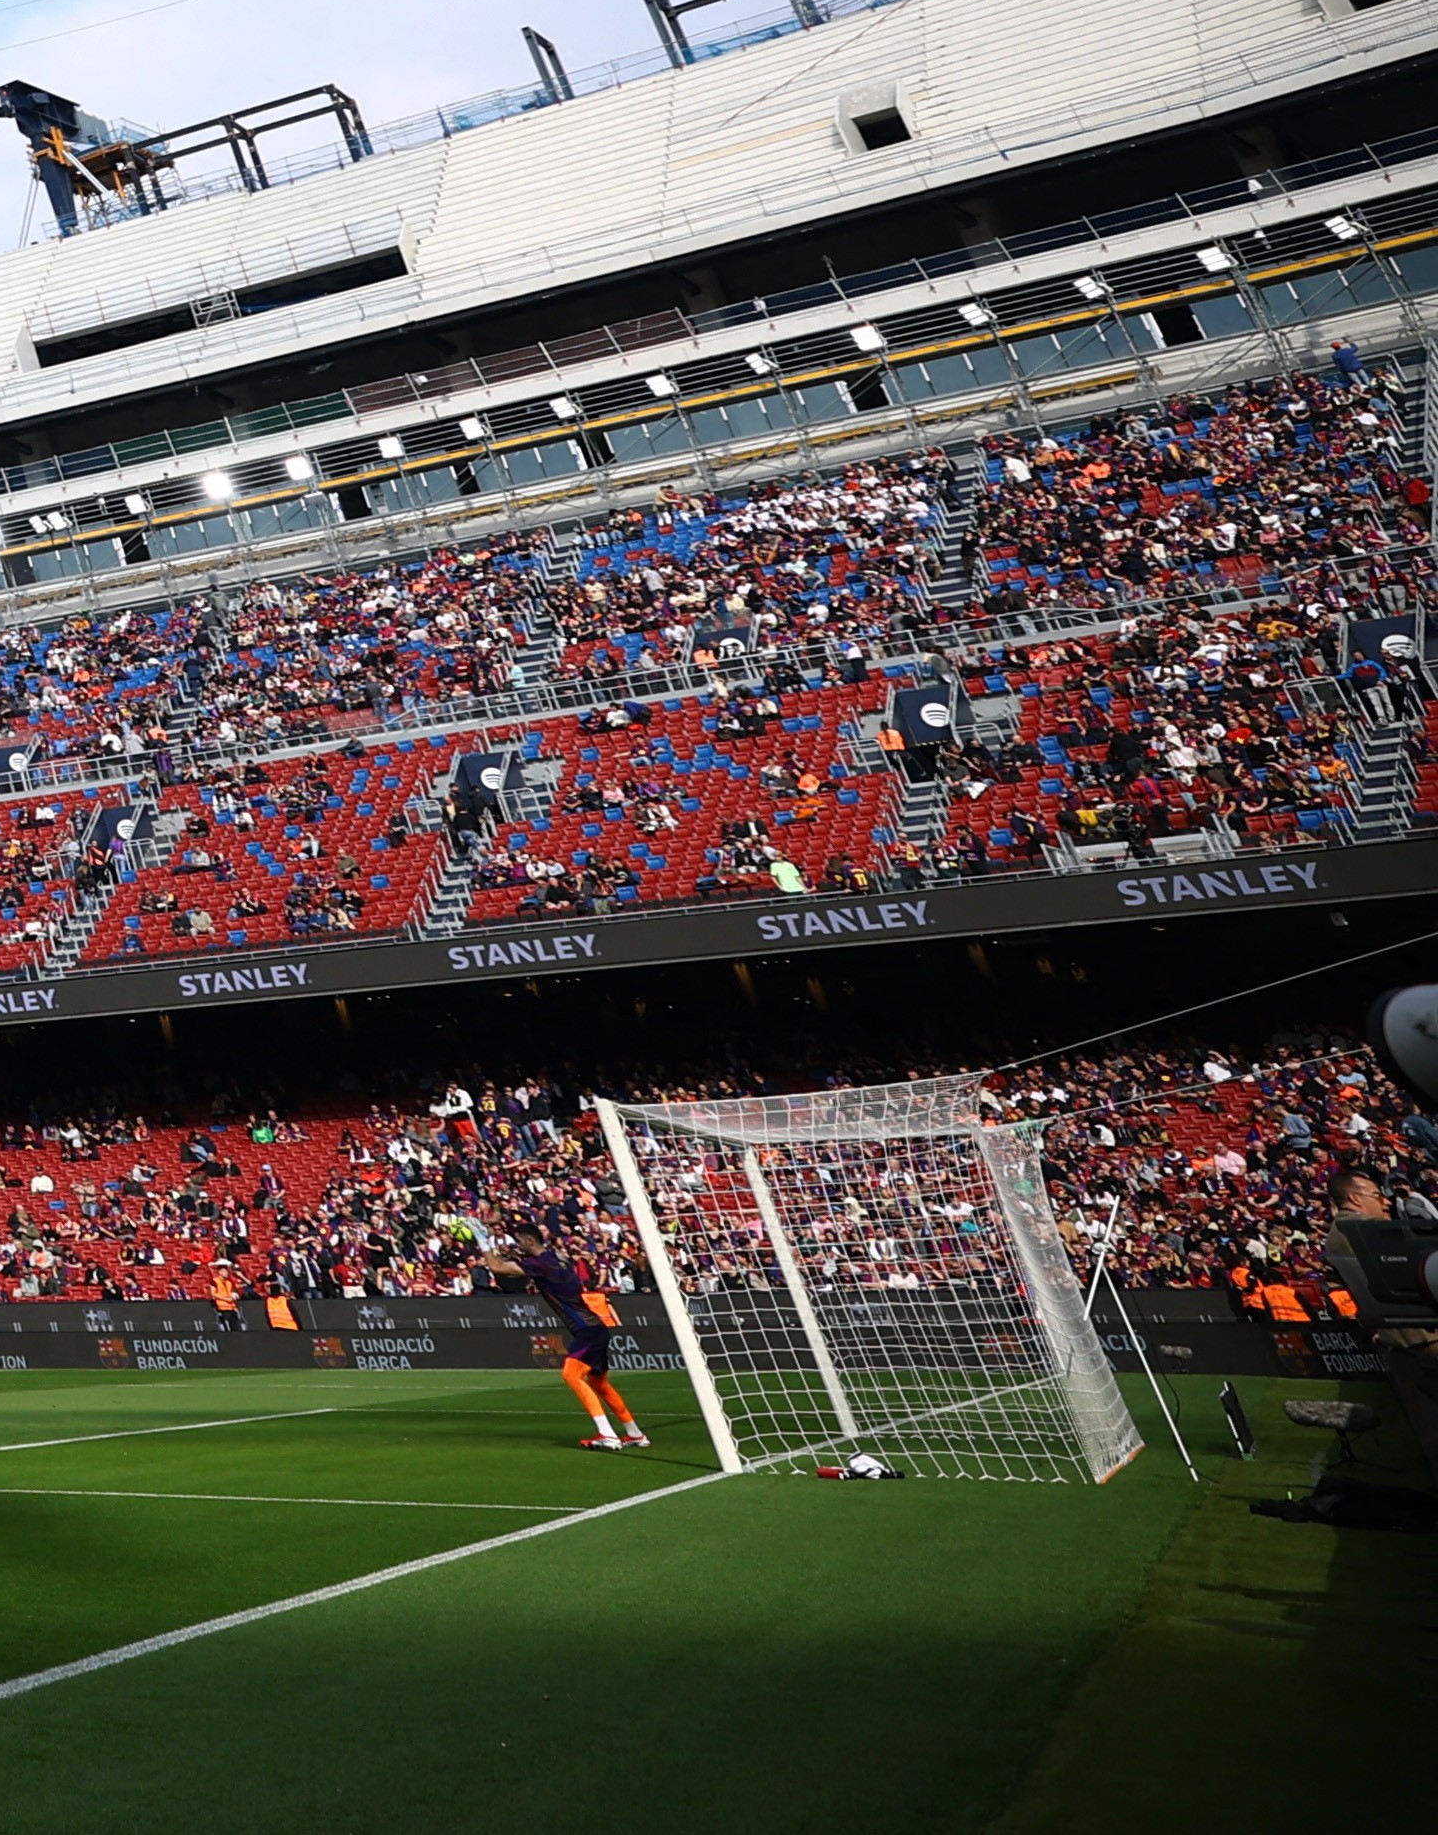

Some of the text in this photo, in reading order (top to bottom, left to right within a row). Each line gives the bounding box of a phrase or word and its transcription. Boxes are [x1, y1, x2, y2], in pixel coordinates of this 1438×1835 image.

[1117, 862, 1317, 906] STANLEY
[756, 900, 928, 941] STANLEY
[447, 933, 597, 970] STANLEY
[179, 963, 309, 997] STANLEY
[133, 1336, 219, 1354] FUNDACIÓN
[351, 1334, 435, 1353] FUNDACIÓ
[1312, 1330, 1358, 1353] BARÇA
